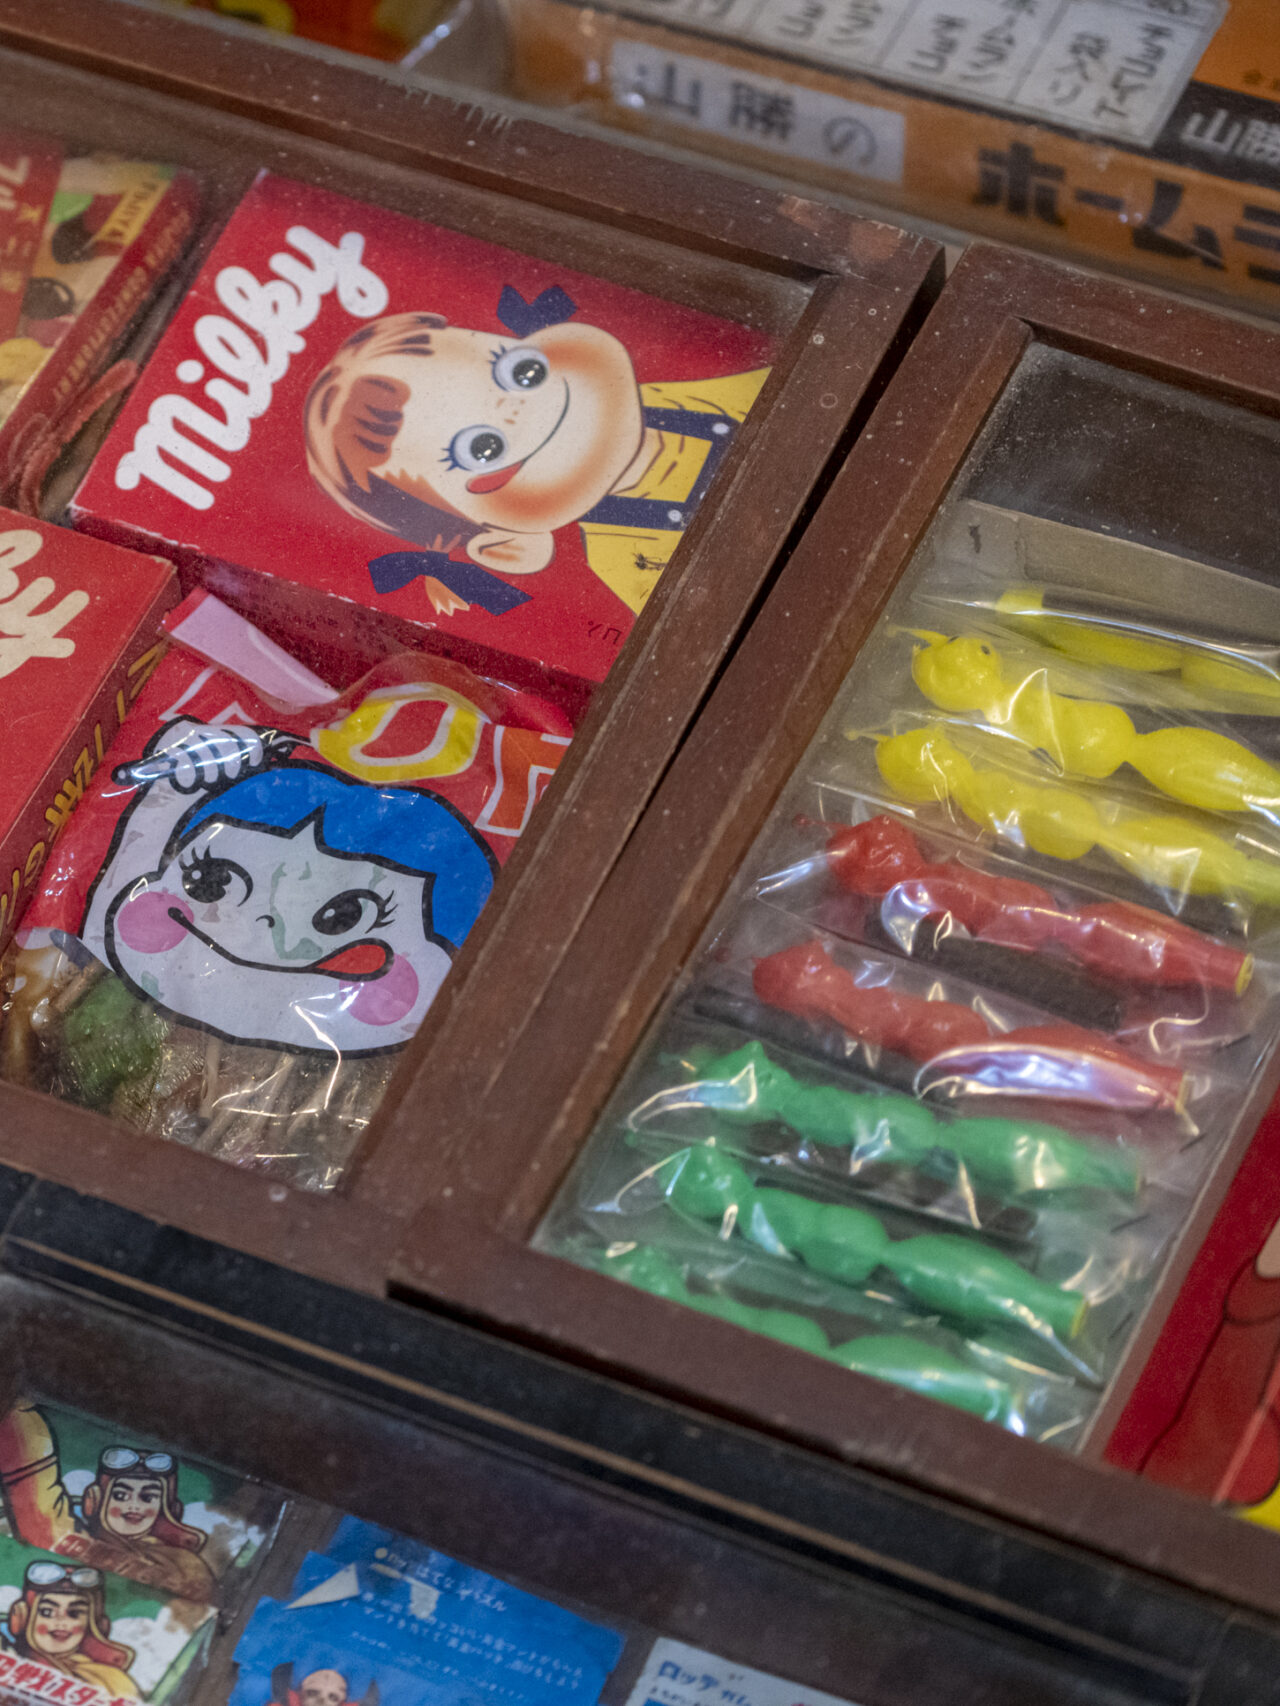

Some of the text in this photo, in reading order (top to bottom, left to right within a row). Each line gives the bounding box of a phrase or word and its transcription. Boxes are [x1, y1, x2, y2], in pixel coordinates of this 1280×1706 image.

[116, 226, 390, 510] Milky
[657, 1661, 719, 1690] ロッテ
